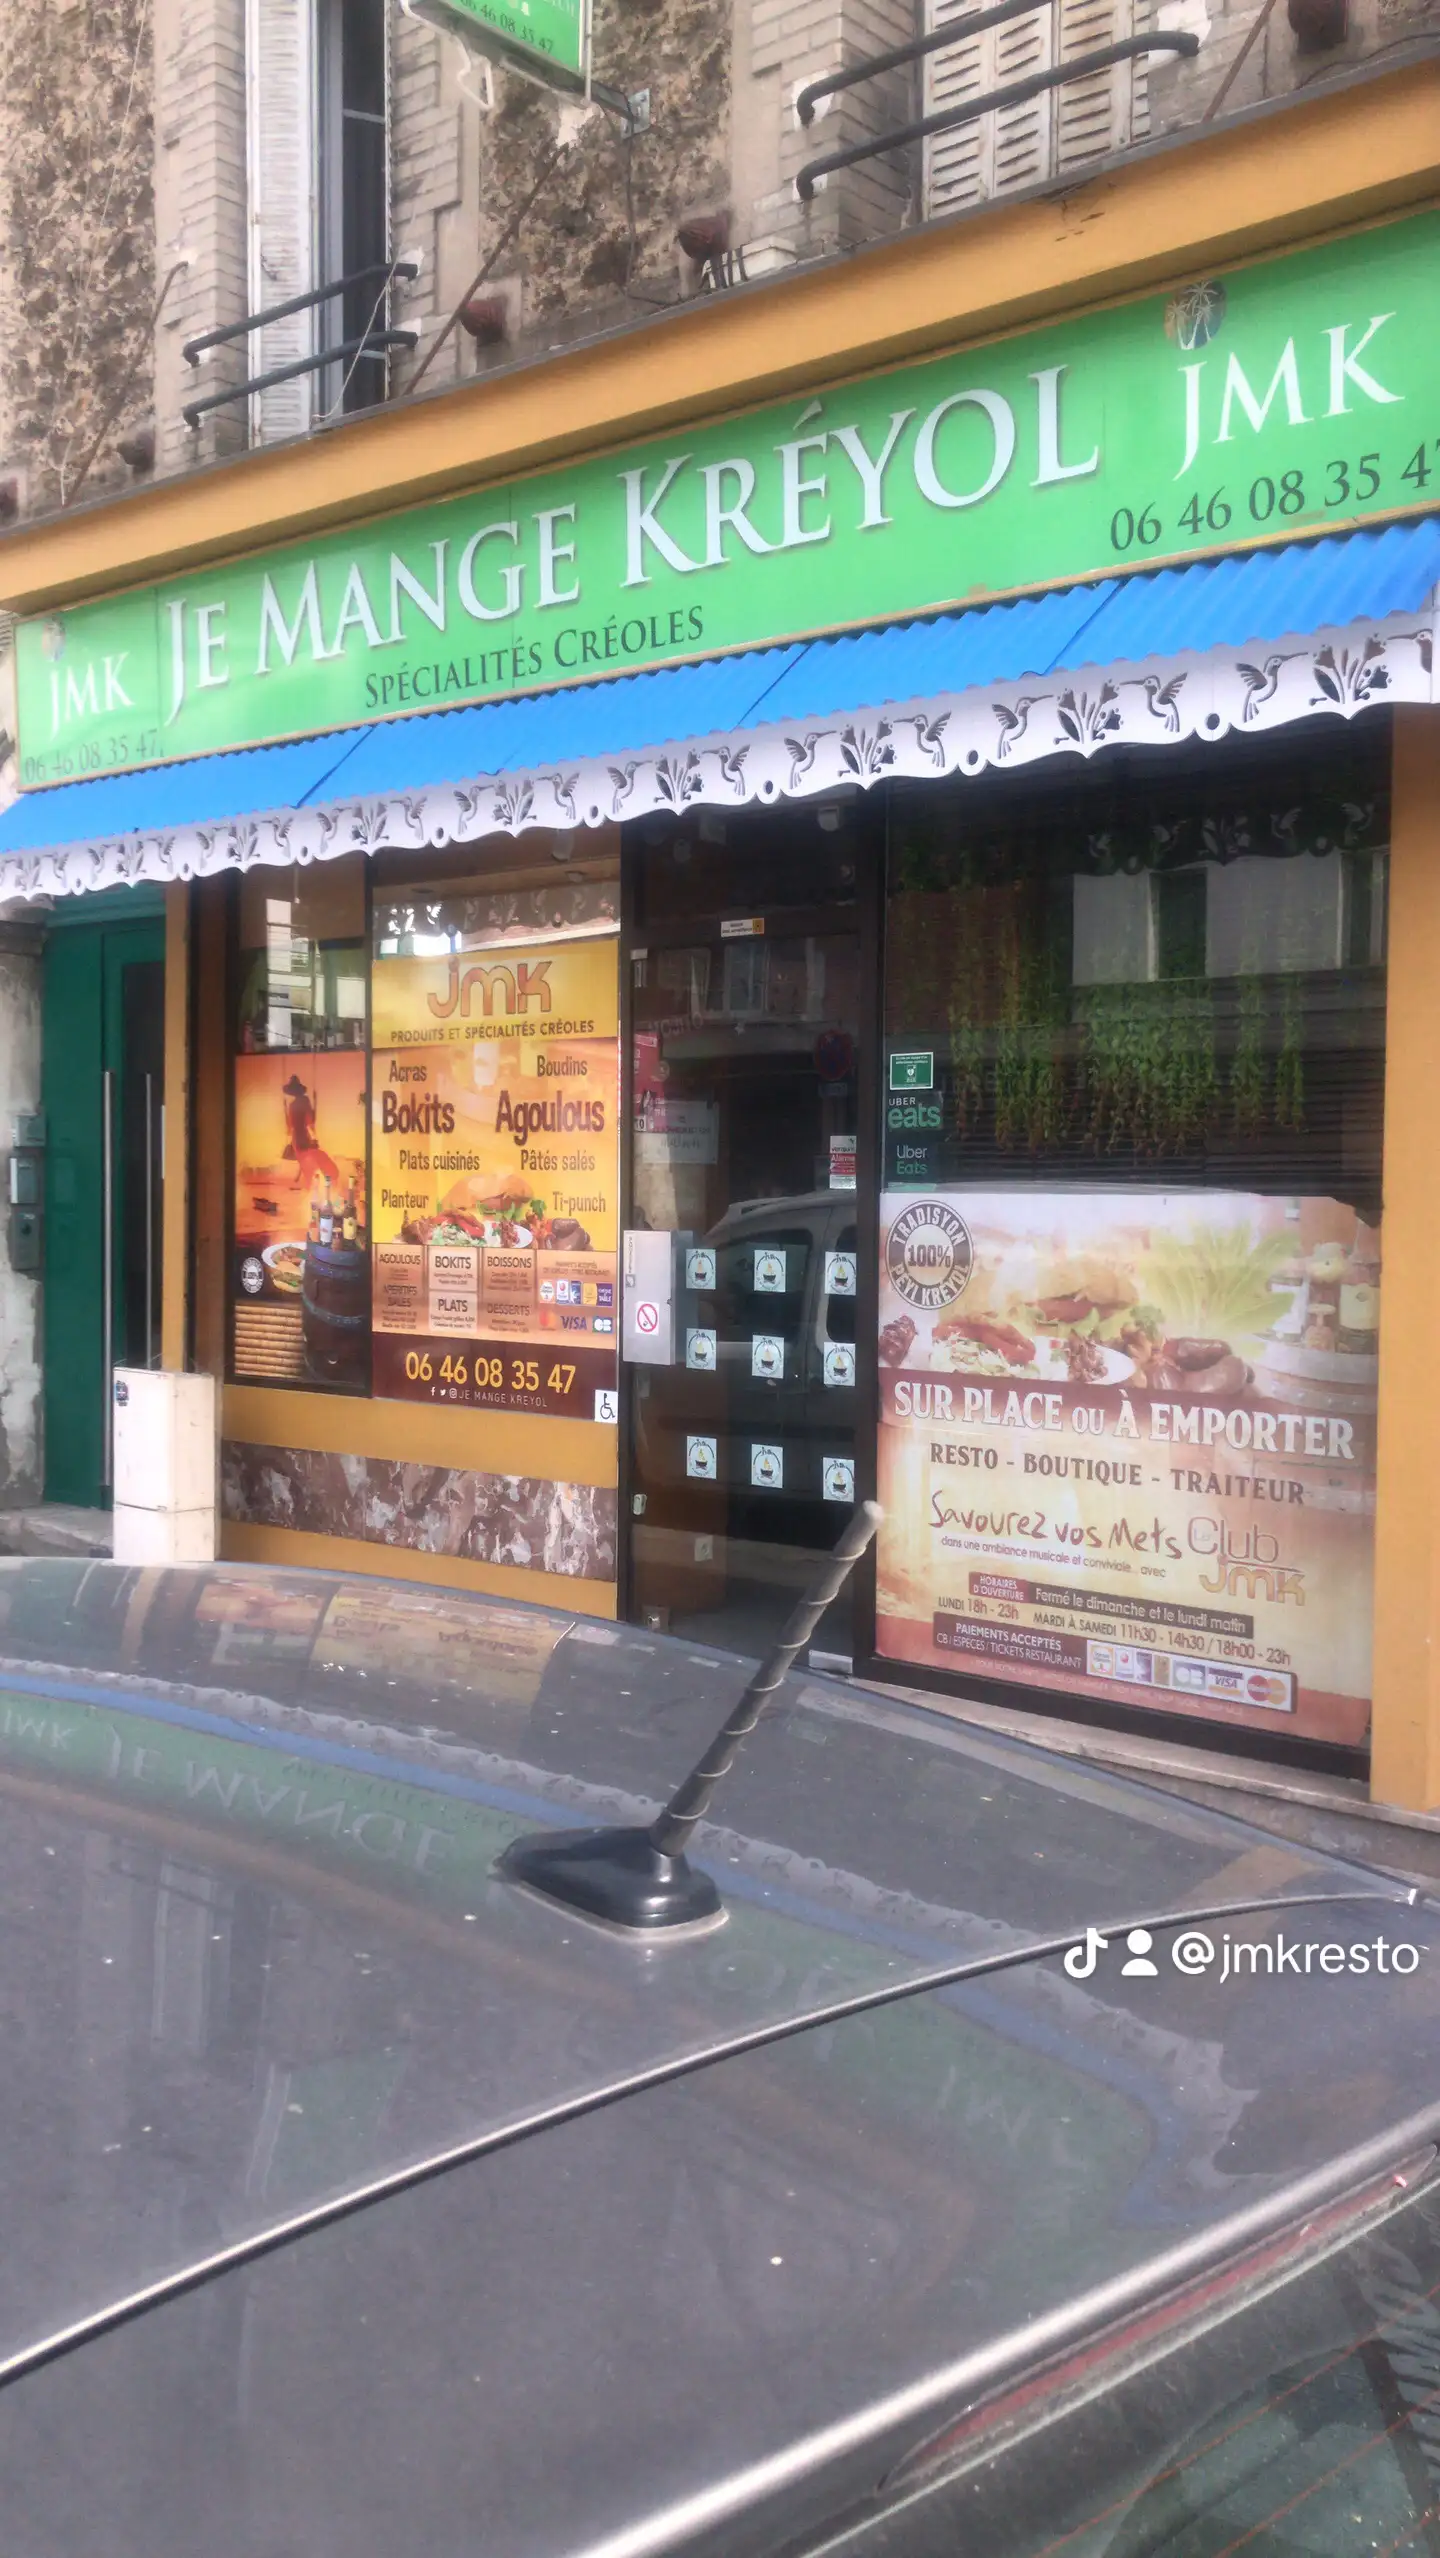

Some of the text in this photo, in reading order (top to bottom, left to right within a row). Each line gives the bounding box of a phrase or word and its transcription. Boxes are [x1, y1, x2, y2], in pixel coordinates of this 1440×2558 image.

[480, 4, 496, 22] 46
[500, 13, 516, 32] 08
[539, 38, 553, 53] 47
[1173, 311, 1406, 482] JMK
[1110, 438, 1440, 551] 06 46 08 35 4
[163, 363, 1102, 727] JE MANGE KRÉYOL
[365, 604, 704, 709] SPÉCIALITÉS CRÉOLES
[49, 650, 137, 742] JMK
[25, 755, 47, 783] 06
[78, 741, 101, 772] 08
[106, 734, 129, 766] 35
[390, 1020, 595, 1043] PRODUITS ET SPÉCIALITÉS CRÉOLES
[389, 1060, 428, 1082] Acras
[536, 1055, 588, 1077] Boudins
[382, 1090, 455, 1134] Bokits
[888, 1097, 916, 1106] UBER
[495, 1090, 605, 1146] Agoulous
[887, 1103, 941, 1129] eats
[399, 1150, 480, 1171] Plats cuisinés
[520, 1149, 596, 1171] Pâtés salés
[896, 1145, 928, 1159] Uber
[896, 1161, 928, 1175] Eats
[381, 1189, 429, 1210] Planteur
[552, 1190, 607, 1216] Ti-punch
[892, 1206, 967, 1246] TRADISYON
[379, 1253, 421, 1265] AGOULOUS
[435, 1256, 472, 1269] BOKITS
[487, 1256, 532, 1269] BOISSONS
[908, 1244, 952, 1268] 100%
[891, 1261, 969, 1306] PEYI KREYOL
[437, 1298, 468, 1312] PLATS
[487, 1303, 531, 1316] DESSERTS
[560, 1316, 588, 1331] VISA
[406, 1352, 577, 1394] 06 46 08 35 47
[458, 1389, 470, 1400] JE
[474, 1391, 507, 1404] MANGE
[893, 1380, 955, 1420] SUR
[961, 1386, 1063, 1433] PLACE
[1114, 1388, 1141, 1439] À
[1149, 1402, 1356, 1461] EMPORTER
[930, 1442, 999, 1471] RESTO
[1023, 1453, 1143, 1488] BOUTIQUE
[1169, 1467, 1307, 1505] TRAITEUR
[928, 1490, 1183, 1560] Savourez vos Mets
[1187, 1516, 1279, 1563] Club
[941, 1535, 962, 1548] dans
[963, 1540, 980, 1551] une
[981, 1541, 1028, 1558] ambiance
[1029, 1547, 1070, 1565] musicale
[1071, 1554, 1082, 1566] et
[1140, 1565, 1167, 1578] avec
[973, 1585, 1025, 1601] D'OUVERTURE
[979, 1575, 1018, 1590] HORAIRES
[1035, 1587, 1246, 1634] Fermé le dimanche et le lundi matin
[938, 1596, 965, 1610] LUNDI
[968, 1598, 988, 1615] 18h
[997, 1603, 1020, 1621] 23h
[1033, 1612, 1065, 1628] MARDI
[1068, 1613, 1077, 1630] À
[1079, 1619, 1117, 1637] SAMEDI
[1121, 1623, 1157, 1644] 11h30
[1168, 1630, 1205, 1651] 14h30
[1217, 1638, 1256, 1660] 18h00
[1266, 1647, 1291, 1666] 23h
[955, 1622, 1062, 1651] PAIEMENTS ACCEPTÉS
[936, 1632, 948, 1645] CB
[990, 1641, 1025, 1659] TICKETS
[1025, 1648, 1083, 1669] RESTAURANT
[1215, 1675, 1238, 1689] VISA
